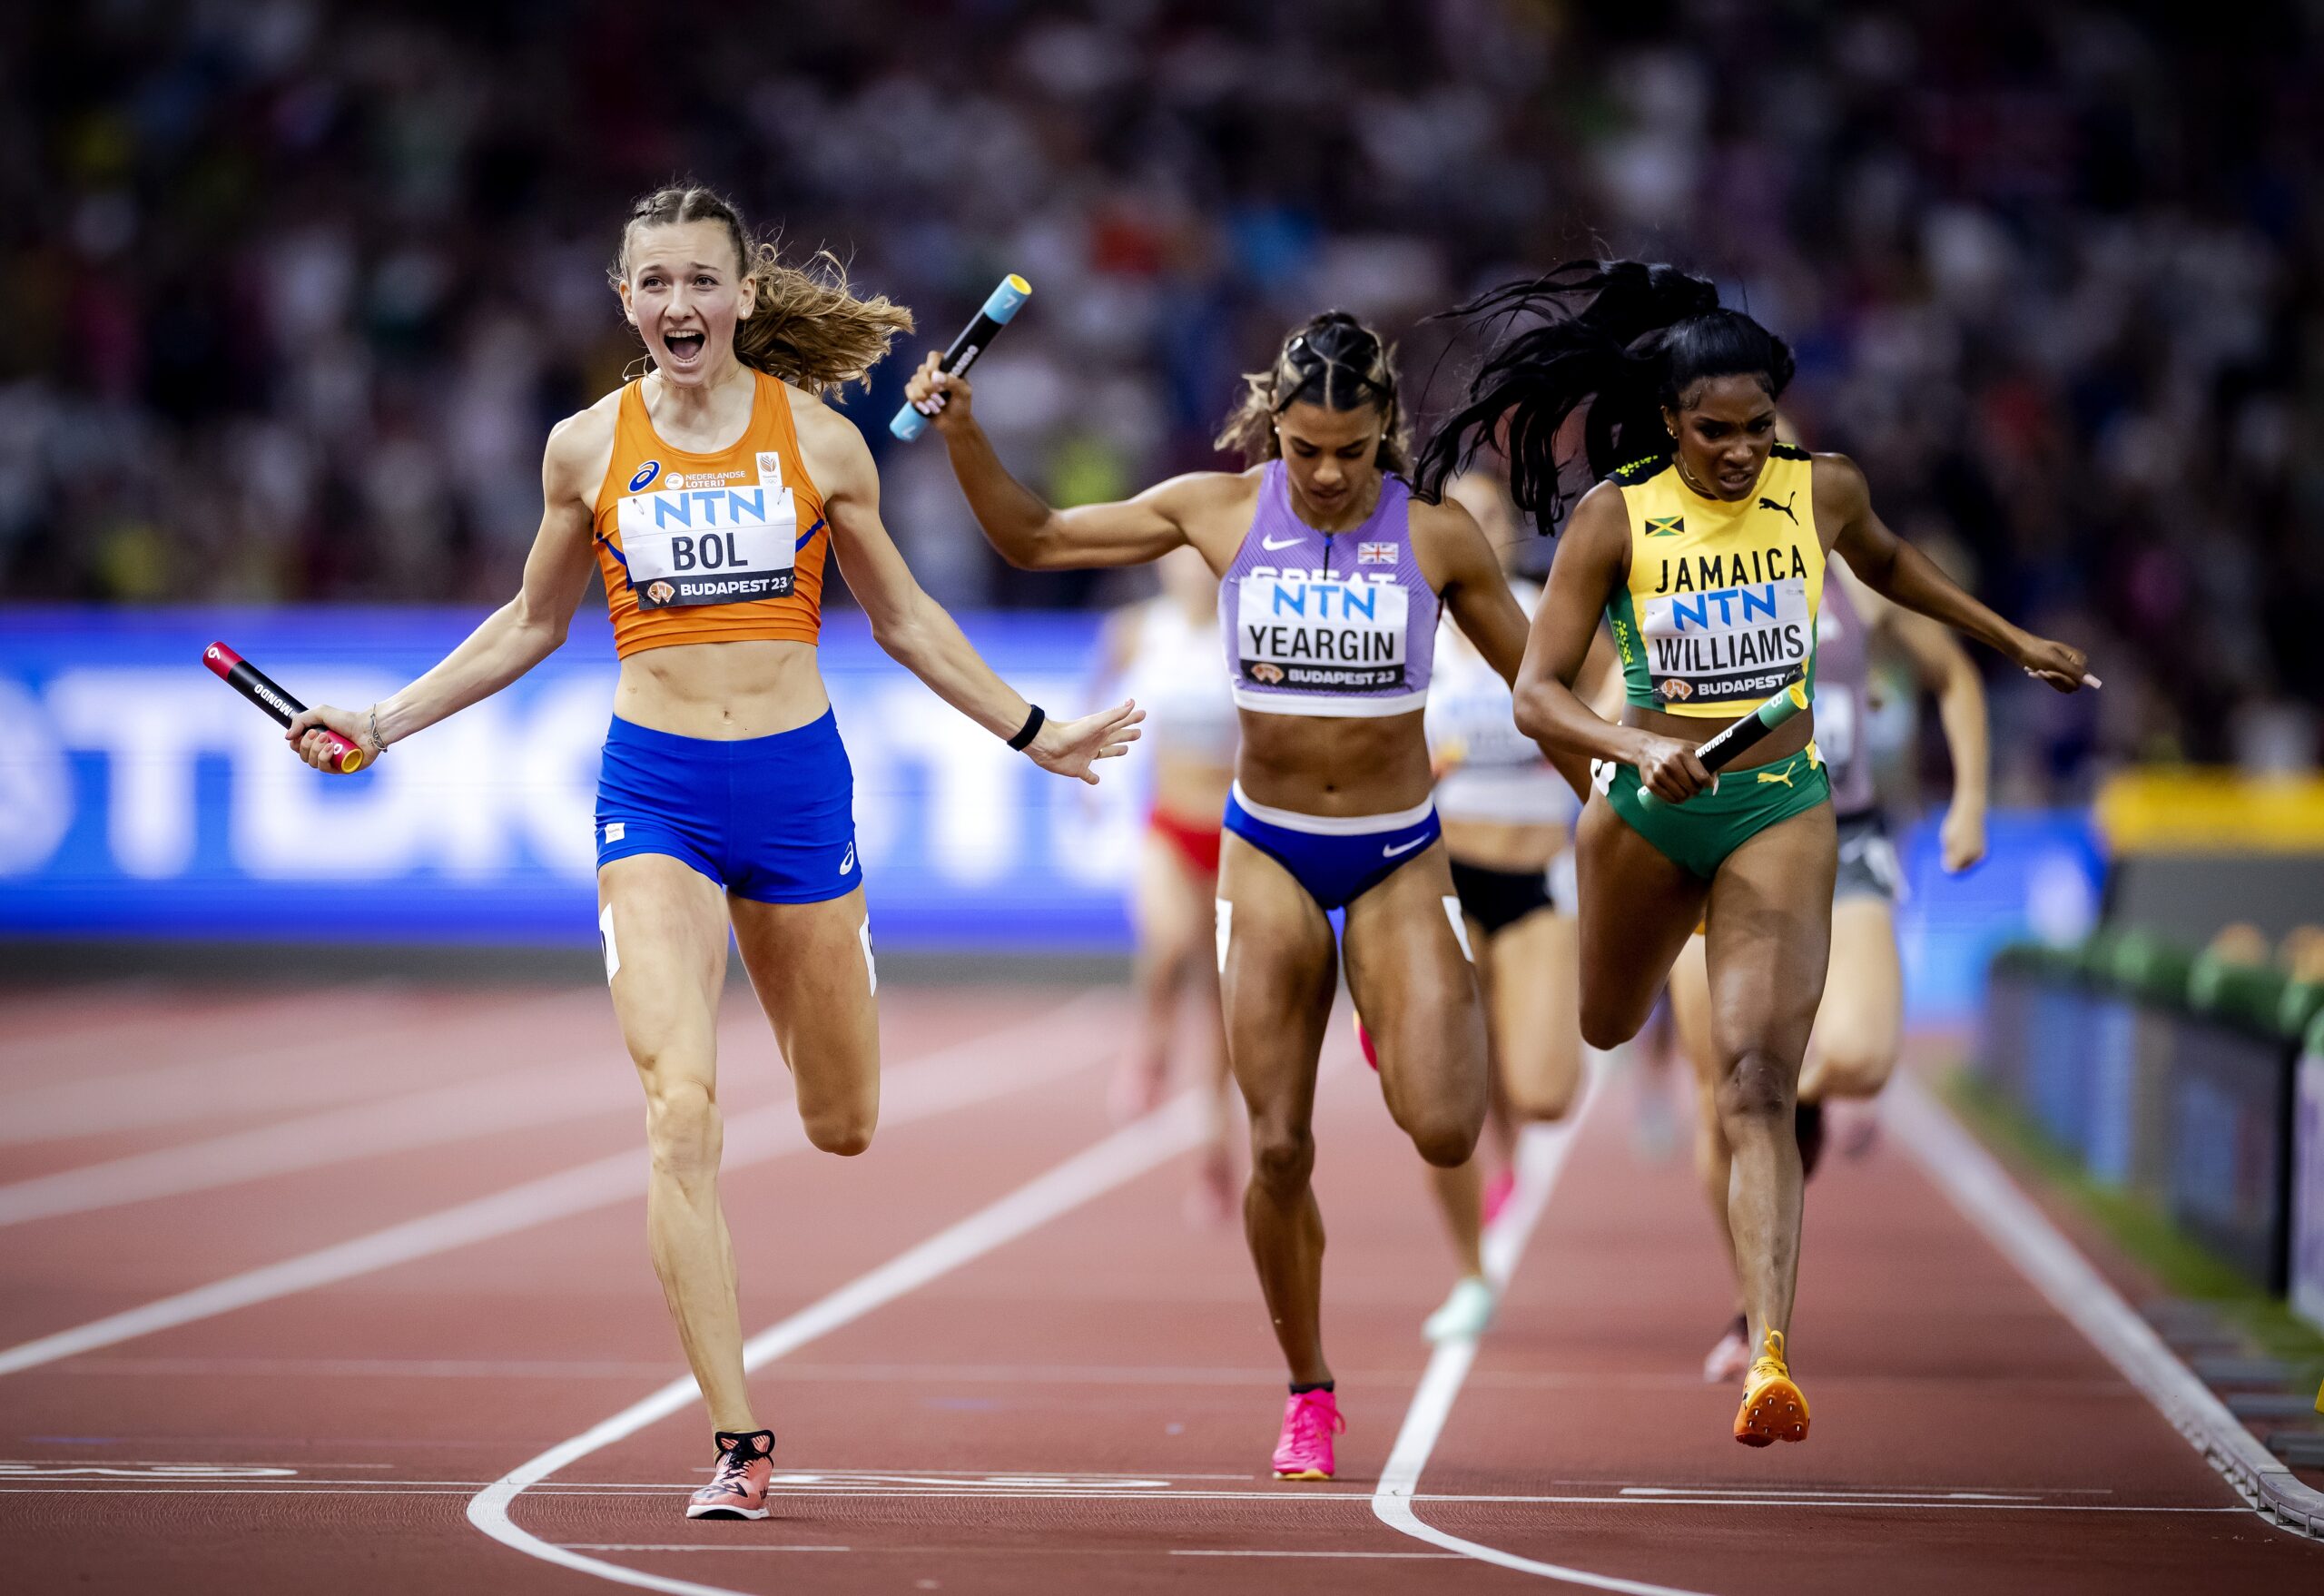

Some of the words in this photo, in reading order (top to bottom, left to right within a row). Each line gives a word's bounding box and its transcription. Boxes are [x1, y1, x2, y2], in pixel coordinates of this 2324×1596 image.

[950, 345, 979, 376] ONDO
[685, 470, 745, 480] NEDERLANDSE
[685, 479, 725, 488] LOTERIJ
[654, 488, 765, 529] NTN
[672, 532, 748, 571] BOL
[1655, 545, 1807, 593] JAMAICA
[680, 581, 768, 596] BUDAPEST
[771, 576, 788, 590] 23
[1273, 583, 1375, 621] NTN
[1672, 584, 1777, 631] NTN
[1248, 625, 1394, 661] YEARGIN
[1656, 624, 1805, 671] WILLIAMS
[1288, 668, 1374, 685] BUDAPEST
[1698, 673, 1786, 696] BUDAPEST
[254, 684, 293, 717] MONDO
[1771, 693, 1783, 708] 8
